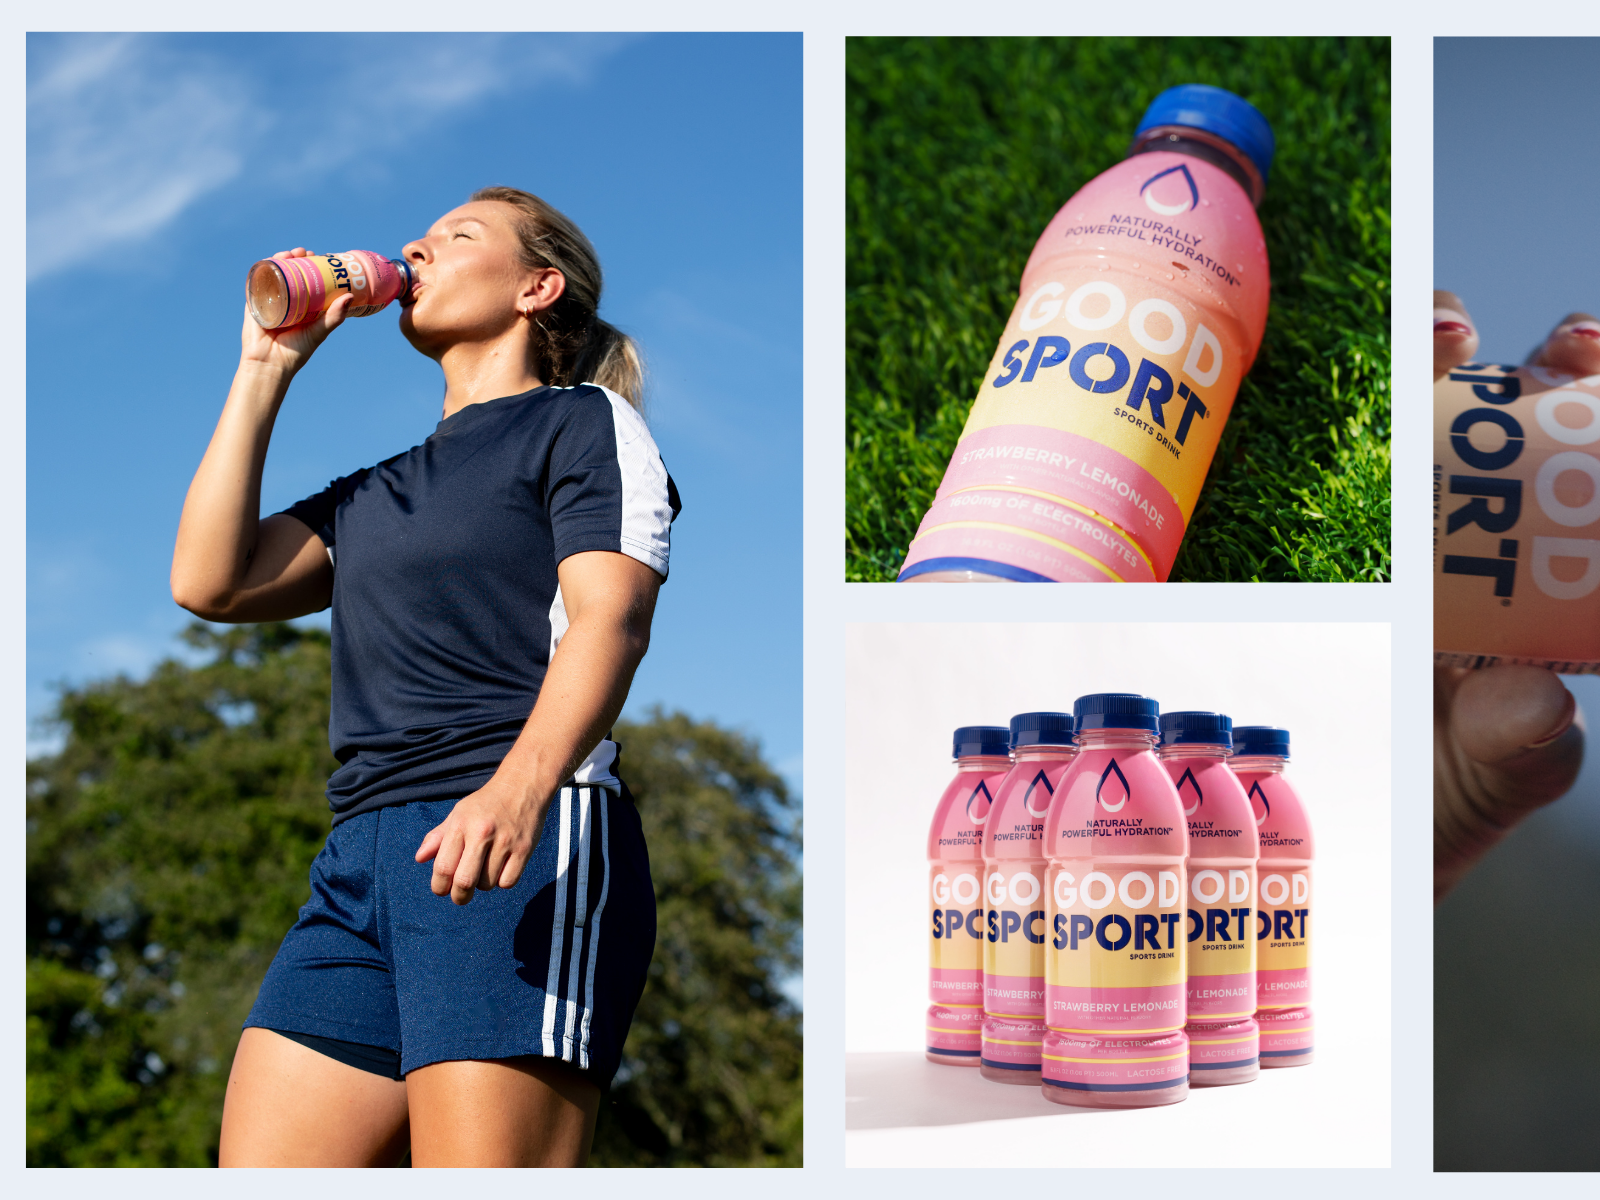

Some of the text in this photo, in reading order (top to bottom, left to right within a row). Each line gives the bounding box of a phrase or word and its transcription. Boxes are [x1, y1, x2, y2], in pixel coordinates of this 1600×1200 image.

[1065, 225, 1146, 241] POWERFUL
[1110, 214, 1202, 247] NATURALLY
[1019, 280, 1223, 388] GOOD
[1113, 407, 1181, 460] SPORTS DRINK
[960, 446, 1165, 530] STRAWBERRY LEMONADE
[1019, 464, 1047, 475] OTHER
[1048, 470, 1085, 487] NATURAL
[1086, 485, 1120, 506] FLAVORS
[950, 494, 1138, 568] 1600mg OF ELECTROLYTES
[1035, 517, 1067, 534] BOTTLE
[997, 540, 1015, 553] OZ
[1014, 824, 1044, 832] NATUR
[1086, 819, 1143, 828] NATURALLY
[993, 832, 1037, 841] POWERFUL
[1062, 828, 1112, 838] POWERFUL
[938, 838, 977, 846] POWERFUL
[932, 873, 981, 906] GO
[987, 871, 1041, 906] GO
[1053, 871, 1180, 910] GOOD
[1191, 869, 1250, 905] OD
[1260, 873, 1309, 906] OD
[1265, 980, 1308, 991] LEMONADE
[987, 988, 1045, 1000] STRAWBERRY
[1196, 987, 1248, 999] LEMONADE
[1053, 1000, 1120, 1013] STRAWBERRY
[1123, 999, 1179, 1012] LEMONADE
[961, 1013, 973, 1021] OF
[1089, 1040, 1103, 1048] OF
[1268, 1037, 1299, 1046] LACTOSE
[1200, 1046, 1251, 1058] LACTOSE FREE
[1127, 1064, 1181, 1078] LACTOSE FREE
